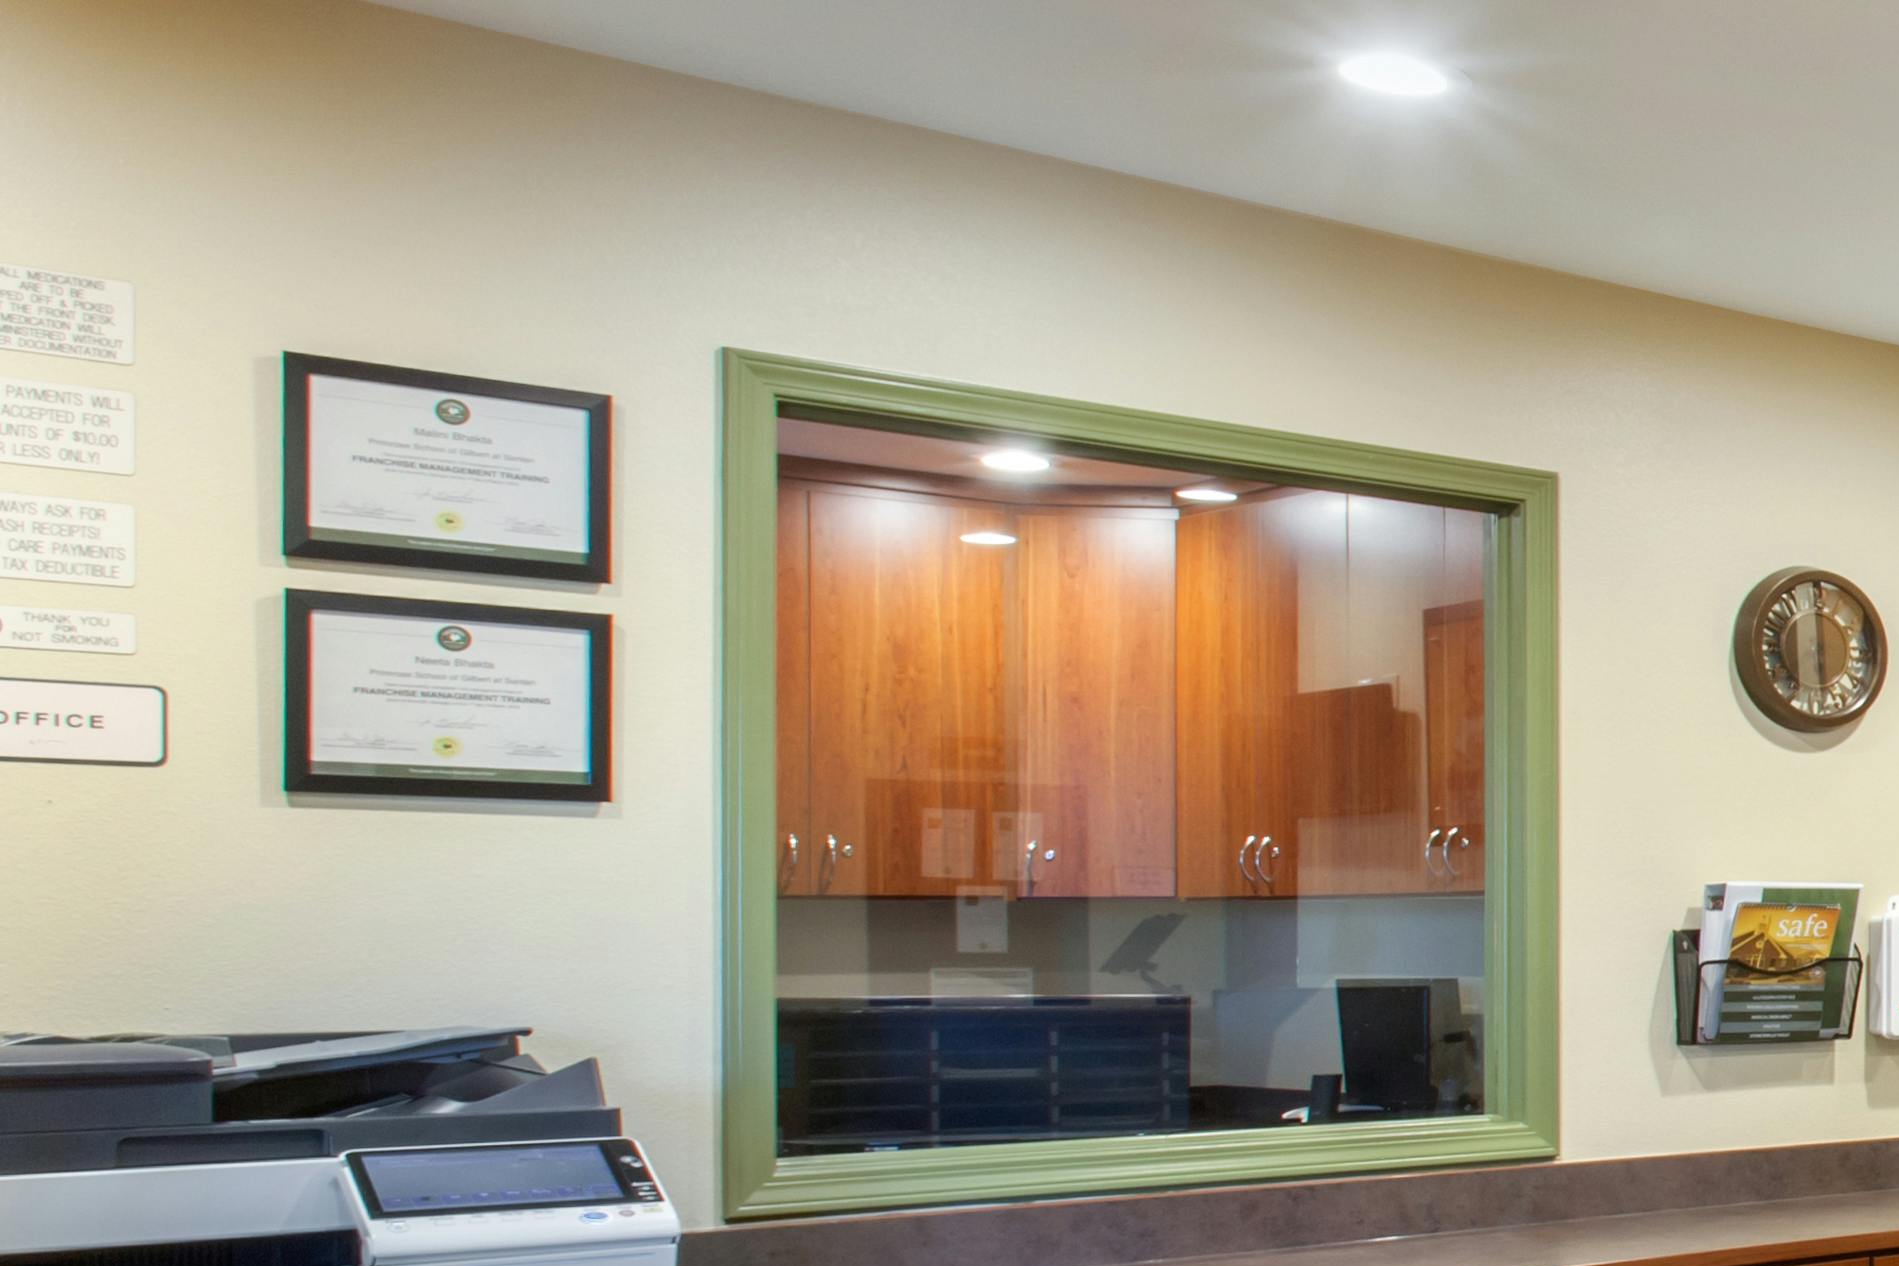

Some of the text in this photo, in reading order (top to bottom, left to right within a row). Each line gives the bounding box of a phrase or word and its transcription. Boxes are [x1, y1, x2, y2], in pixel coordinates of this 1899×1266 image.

[26, 270, 106, 291] MEDICATIONS
[49, 285, 64, 296] TO
[38, 305, 75, 320] FRONT
[73, 300, 115, 315] PICKED
[72, 333, 123, 350] WITHOUT
[5, 384, 125, 412] PAYMENTS WILL
[1, 403, 111, 428] ACCEPTED FOR
[45, 427, 64, 441] OF
[12, 443, 51, 460] LESS
[352, 454, 416, 469] FRANCHISE
[419, 461, 497, 478] MANAGEMENT
[500, 469, 550, 484] TRAINING
[45, 503, 72, 518] ASK
[79, 506, 107, 521] FOR
[8, 537, 127, 561] CARE PAYMENTS
[2, 556, 121, 580] TAX DEDUCTIBLE
[23, 611, 111, 628] THANK YOU
[11, 631, 120, 648] NOT SMOKING
[352, 686, 416, 698] FRANCHISE
[420, 690, 498, 703] MANAGEMENT
[502, 695, 551, 705] TRAINING
[1776, 912, 1829, 938] safe
